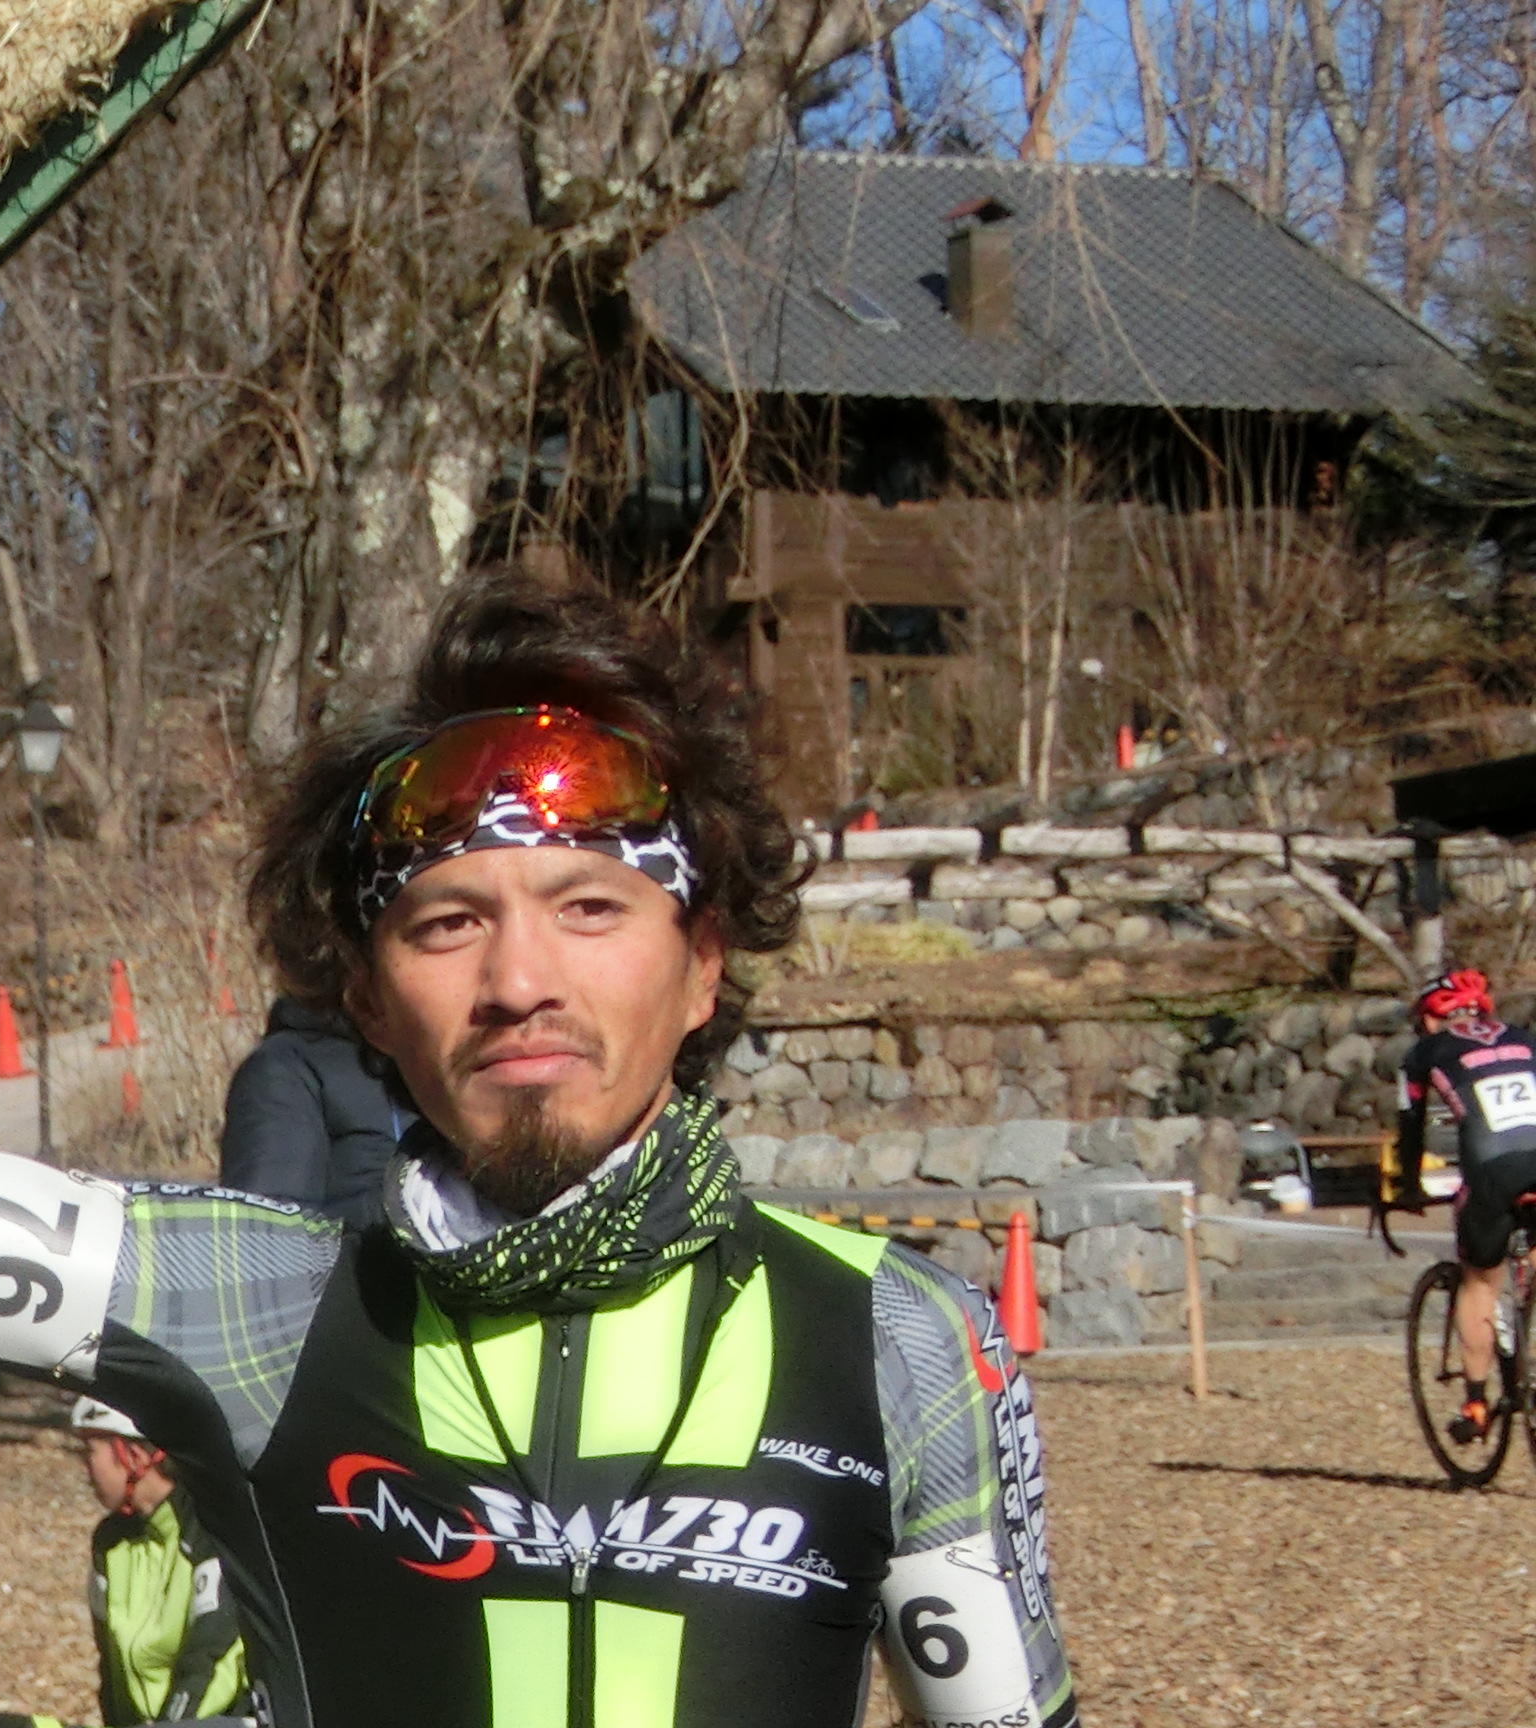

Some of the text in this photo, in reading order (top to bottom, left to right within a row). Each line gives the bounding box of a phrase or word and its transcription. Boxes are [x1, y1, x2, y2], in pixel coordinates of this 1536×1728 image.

[1486, 1081, 1531, 1106] 72
[758, 1438, 884, 1486] WAVE ONE
[614, 1551, 676, 1574] OF
[678, 1560, 807, 1598] SPEED
